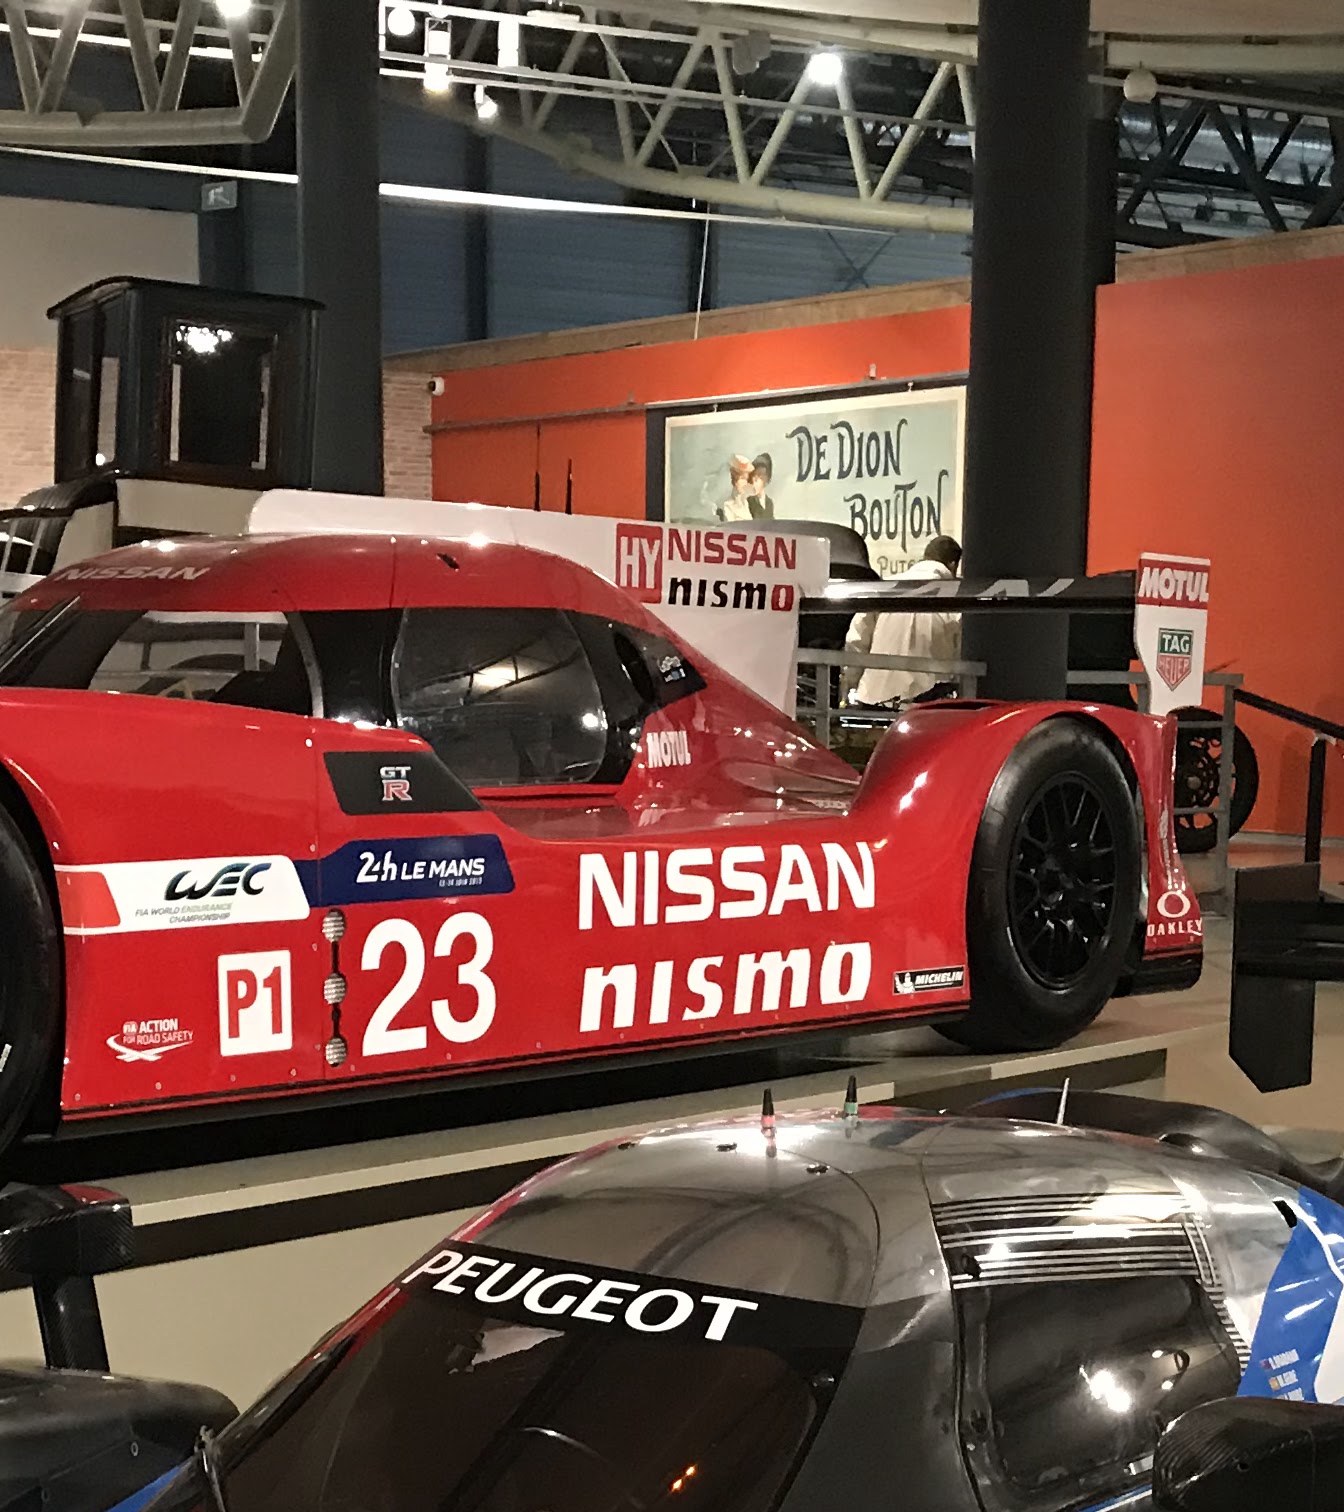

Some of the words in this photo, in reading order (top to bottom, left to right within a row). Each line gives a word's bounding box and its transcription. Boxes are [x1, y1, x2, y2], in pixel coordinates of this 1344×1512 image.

[785, 426, 831, 482] DE
[830, 418, 908, 479] DION
[843, 469, 949, 553] BOUTON
[668, 528, 797, 570] NISSAN
[53, 565, 211, 581] NISSAN
[1139, 567, 1209, 604] MOTUL
[1162, 634, 1191, 654] TAG
[1159, 657, 1191, 686] HEUER
[647, 730, 691, 768] MOTUL
[379, 766, 412, 779] GT
[381, 779, 413, 801] R
[164, 862, 272, 901] WEC
[356, 851, 398, 883] 24h
[400, 861, 427, 880] LE
[428, 858, 485, 879] MANS
[579, 842, 875, 930] NISSAN
[135, 909, 149, 917] FIA
[151, 907, 181, 916] WORLD
[1147, 918, 1203, 937] OAKLEY
[361, 911, 497, 1057] 23
[915, 971, 964, 985] MICHELIN
[227, 965, 283, 1039] P1
[136, 1032, 162, 1046] ROAD
[162, 1030, 194, 1044] SAFETY
[139, 1018, 179, 1032] ACTION
[402, 1249, 758, 1341] PEUGEOT
